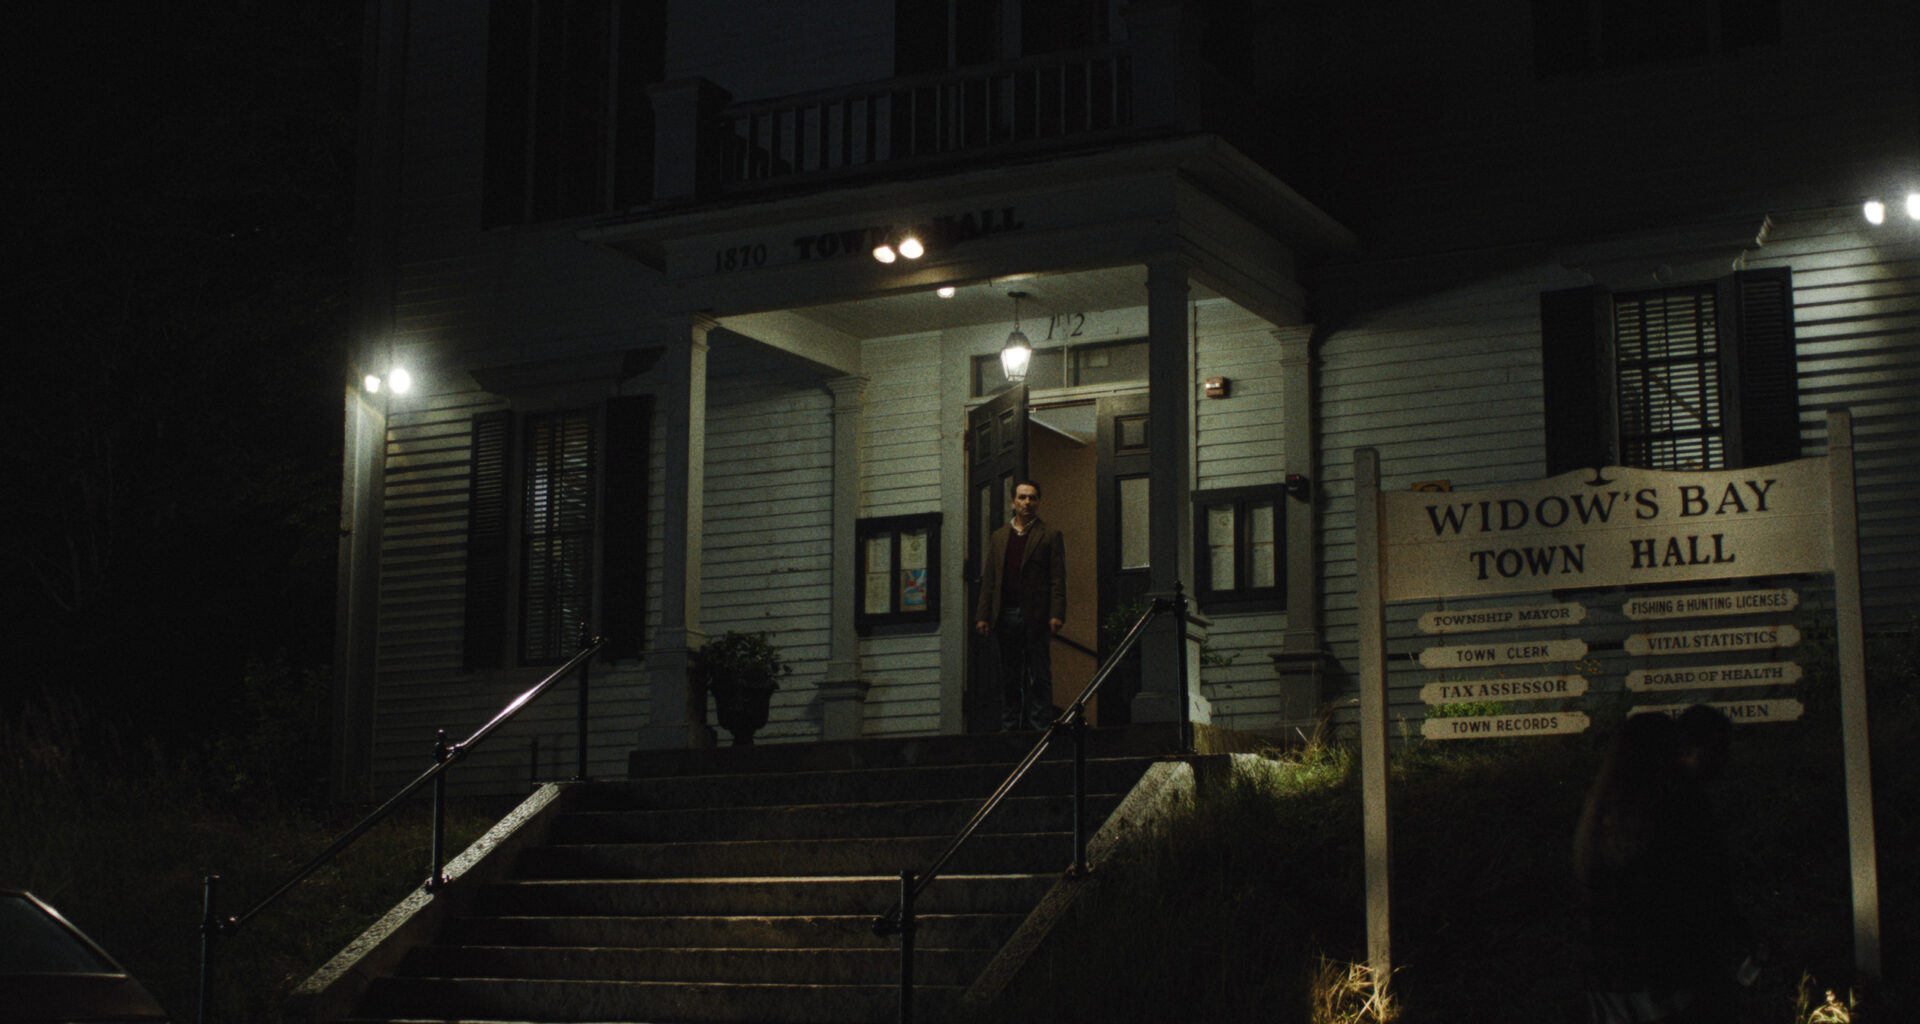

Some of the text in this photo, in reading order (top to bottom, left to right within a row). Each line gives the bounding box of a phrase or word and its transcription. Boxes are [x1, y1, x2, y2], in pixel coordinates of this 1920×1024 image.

[715, 244, 767, 272] 1870
[1426, 479, 1776, 535] WIDOW'S BAY
[1470, 533, 1735, 580] TOWN HALL
[1632, 593, 1788, 615] FISHING & HUNTING LICENSES
[1433, 608, 1570, 626] TOWNSHIP MAYOR
[1647, 631, 1778, 650] VITAL STATISTICS
[1457, 646, 1549, 662] TOWN CLERK
[1644, 667, 1783, 685] BOARD OF HEALTH
[1440, 680, 1567, 698] TAX ASSESSOR
[1453, 717, 1558, 733] TOWN RECORDS
